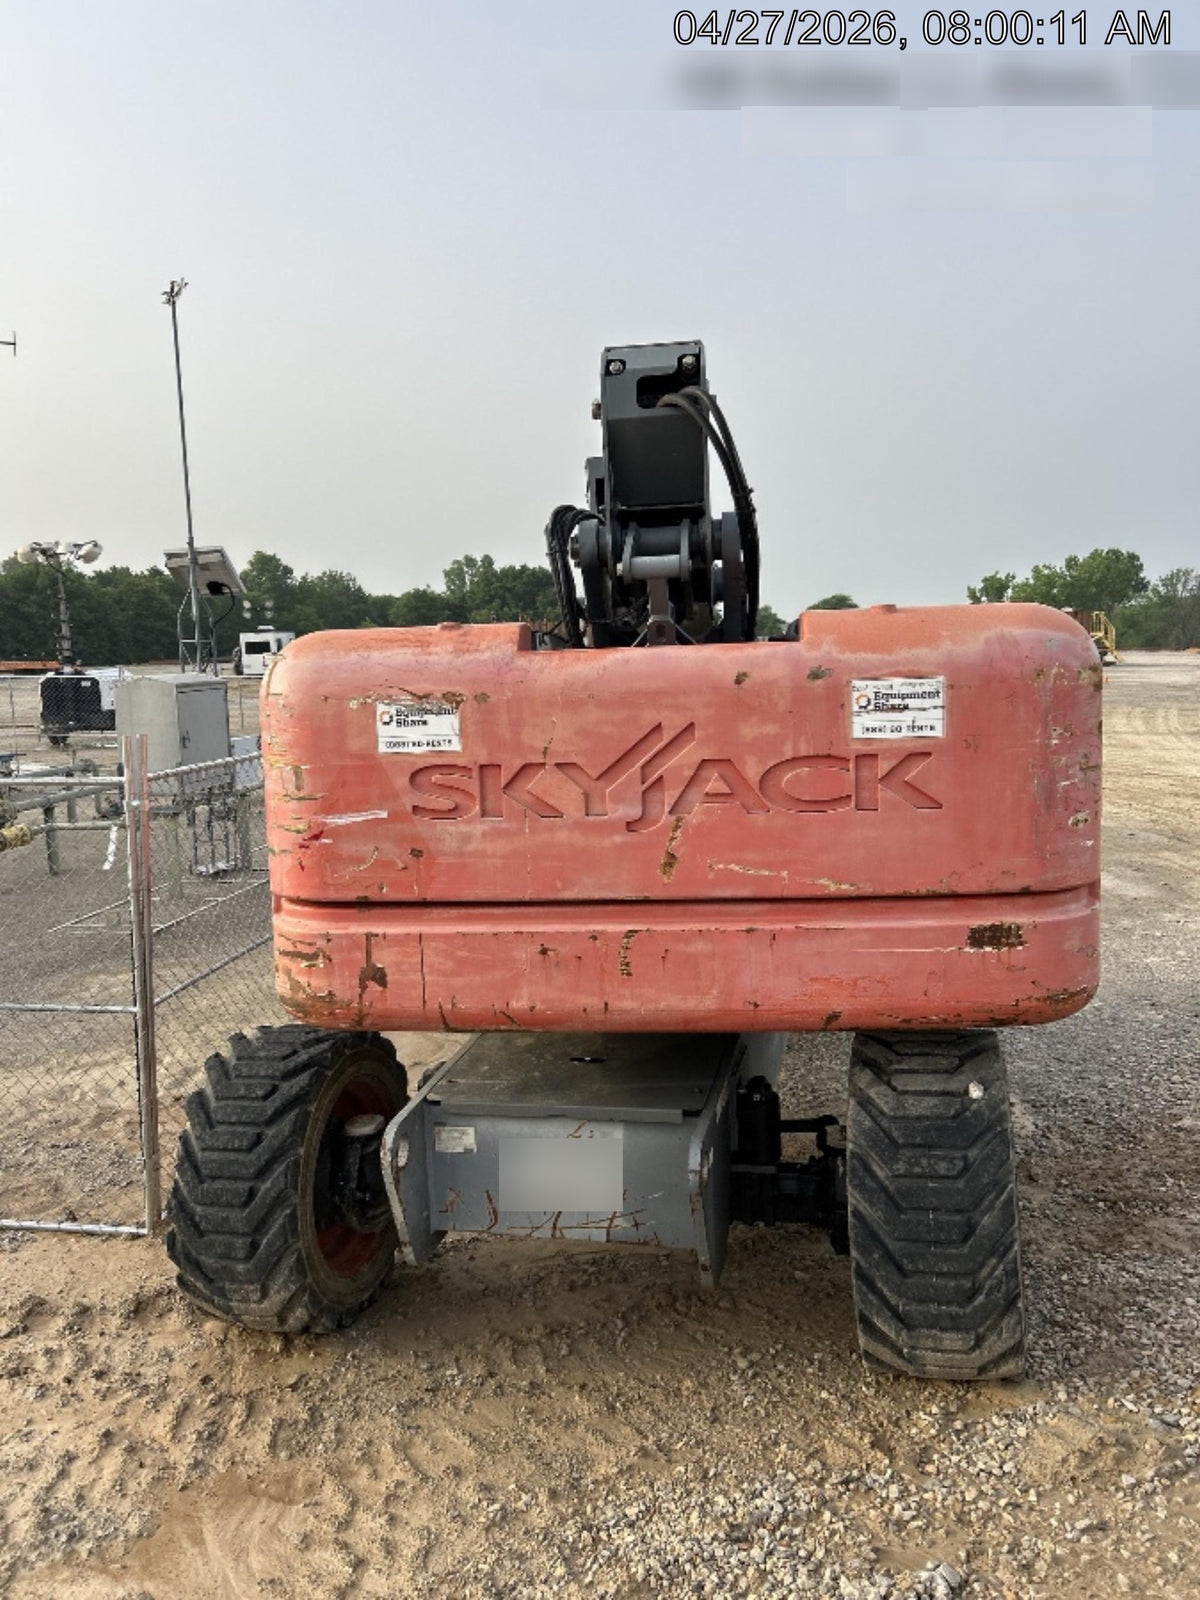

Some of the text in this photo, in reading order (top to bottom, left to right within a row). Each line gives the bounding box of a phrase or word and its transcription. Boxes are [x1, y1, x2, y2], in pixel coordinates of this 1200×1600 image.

[873, 689, 941, 702] Equipment
[395, 718, 428, 728] Share
[408, 721, 944, 833] SKYJACK
